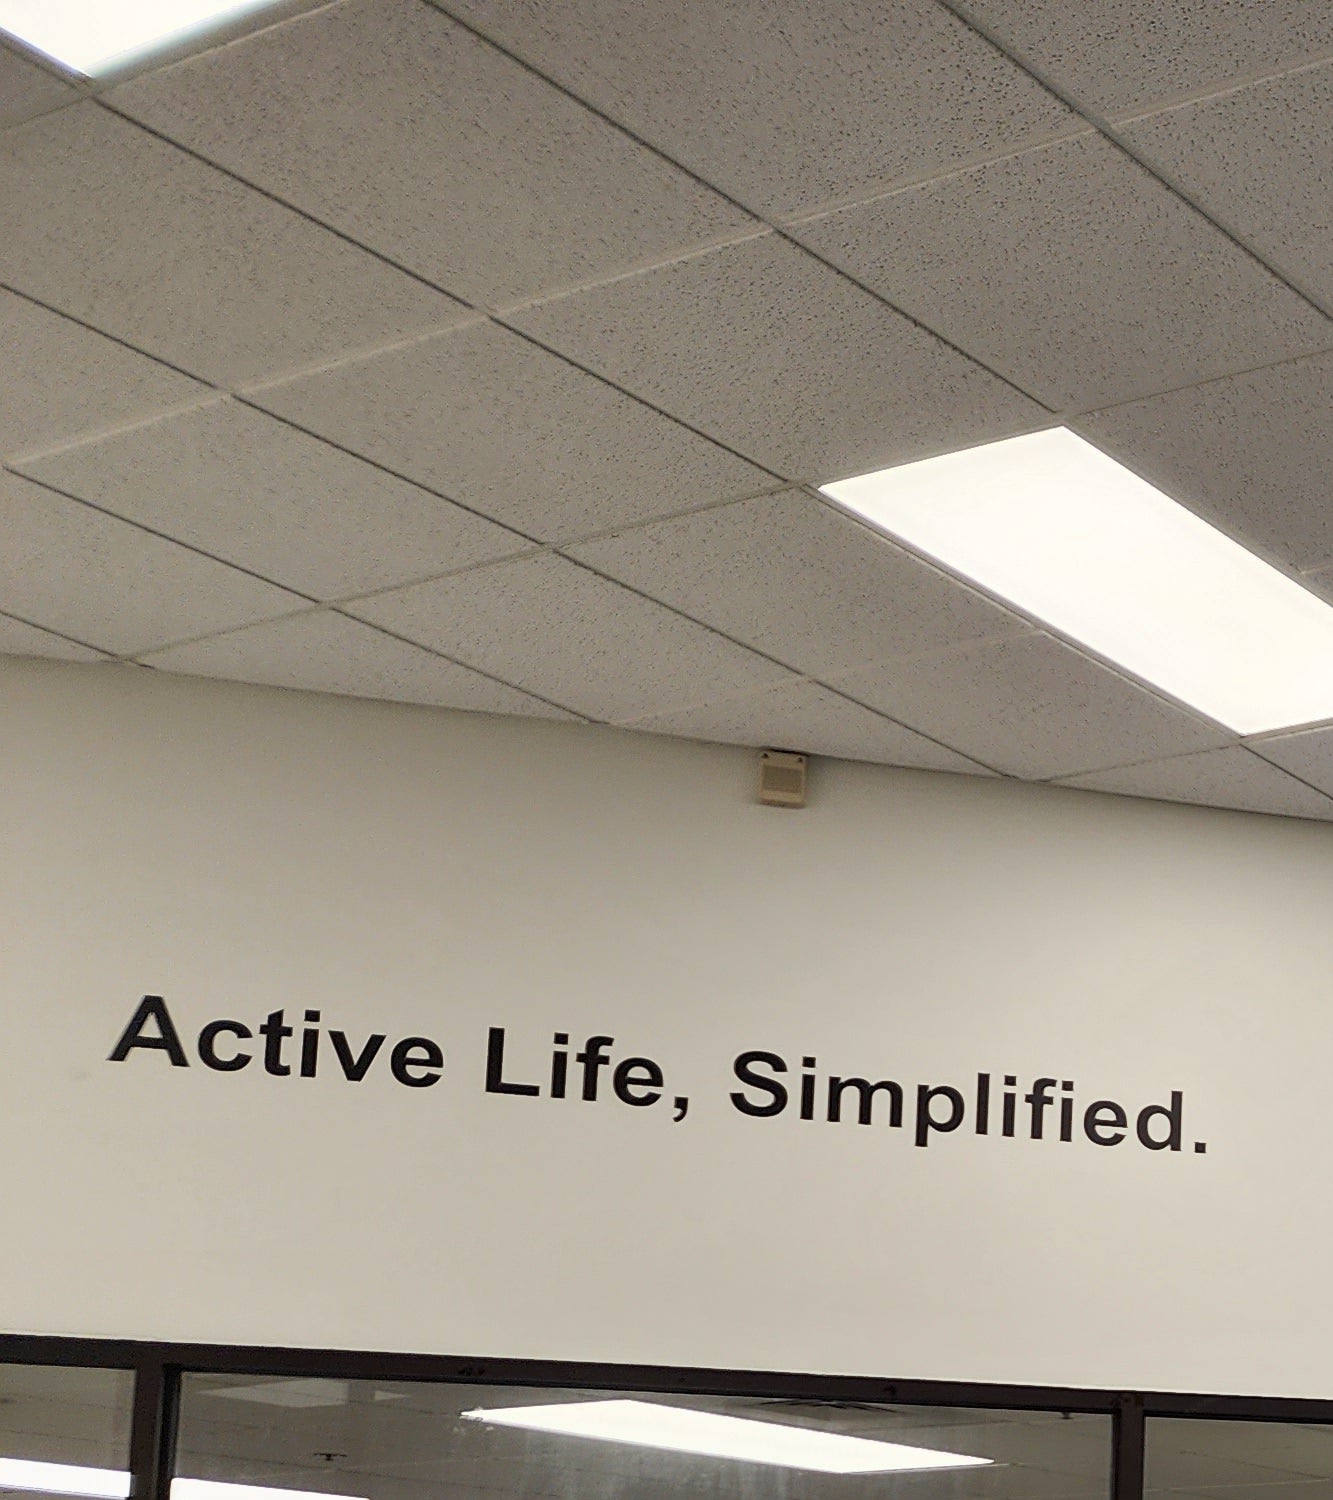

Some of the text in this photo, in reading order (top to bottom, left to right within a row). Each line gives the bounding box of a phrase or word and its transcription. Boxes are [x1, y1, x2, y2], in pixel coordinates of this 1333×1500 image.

[106, 994, 1207, 1154] Active Life, Simplified.
